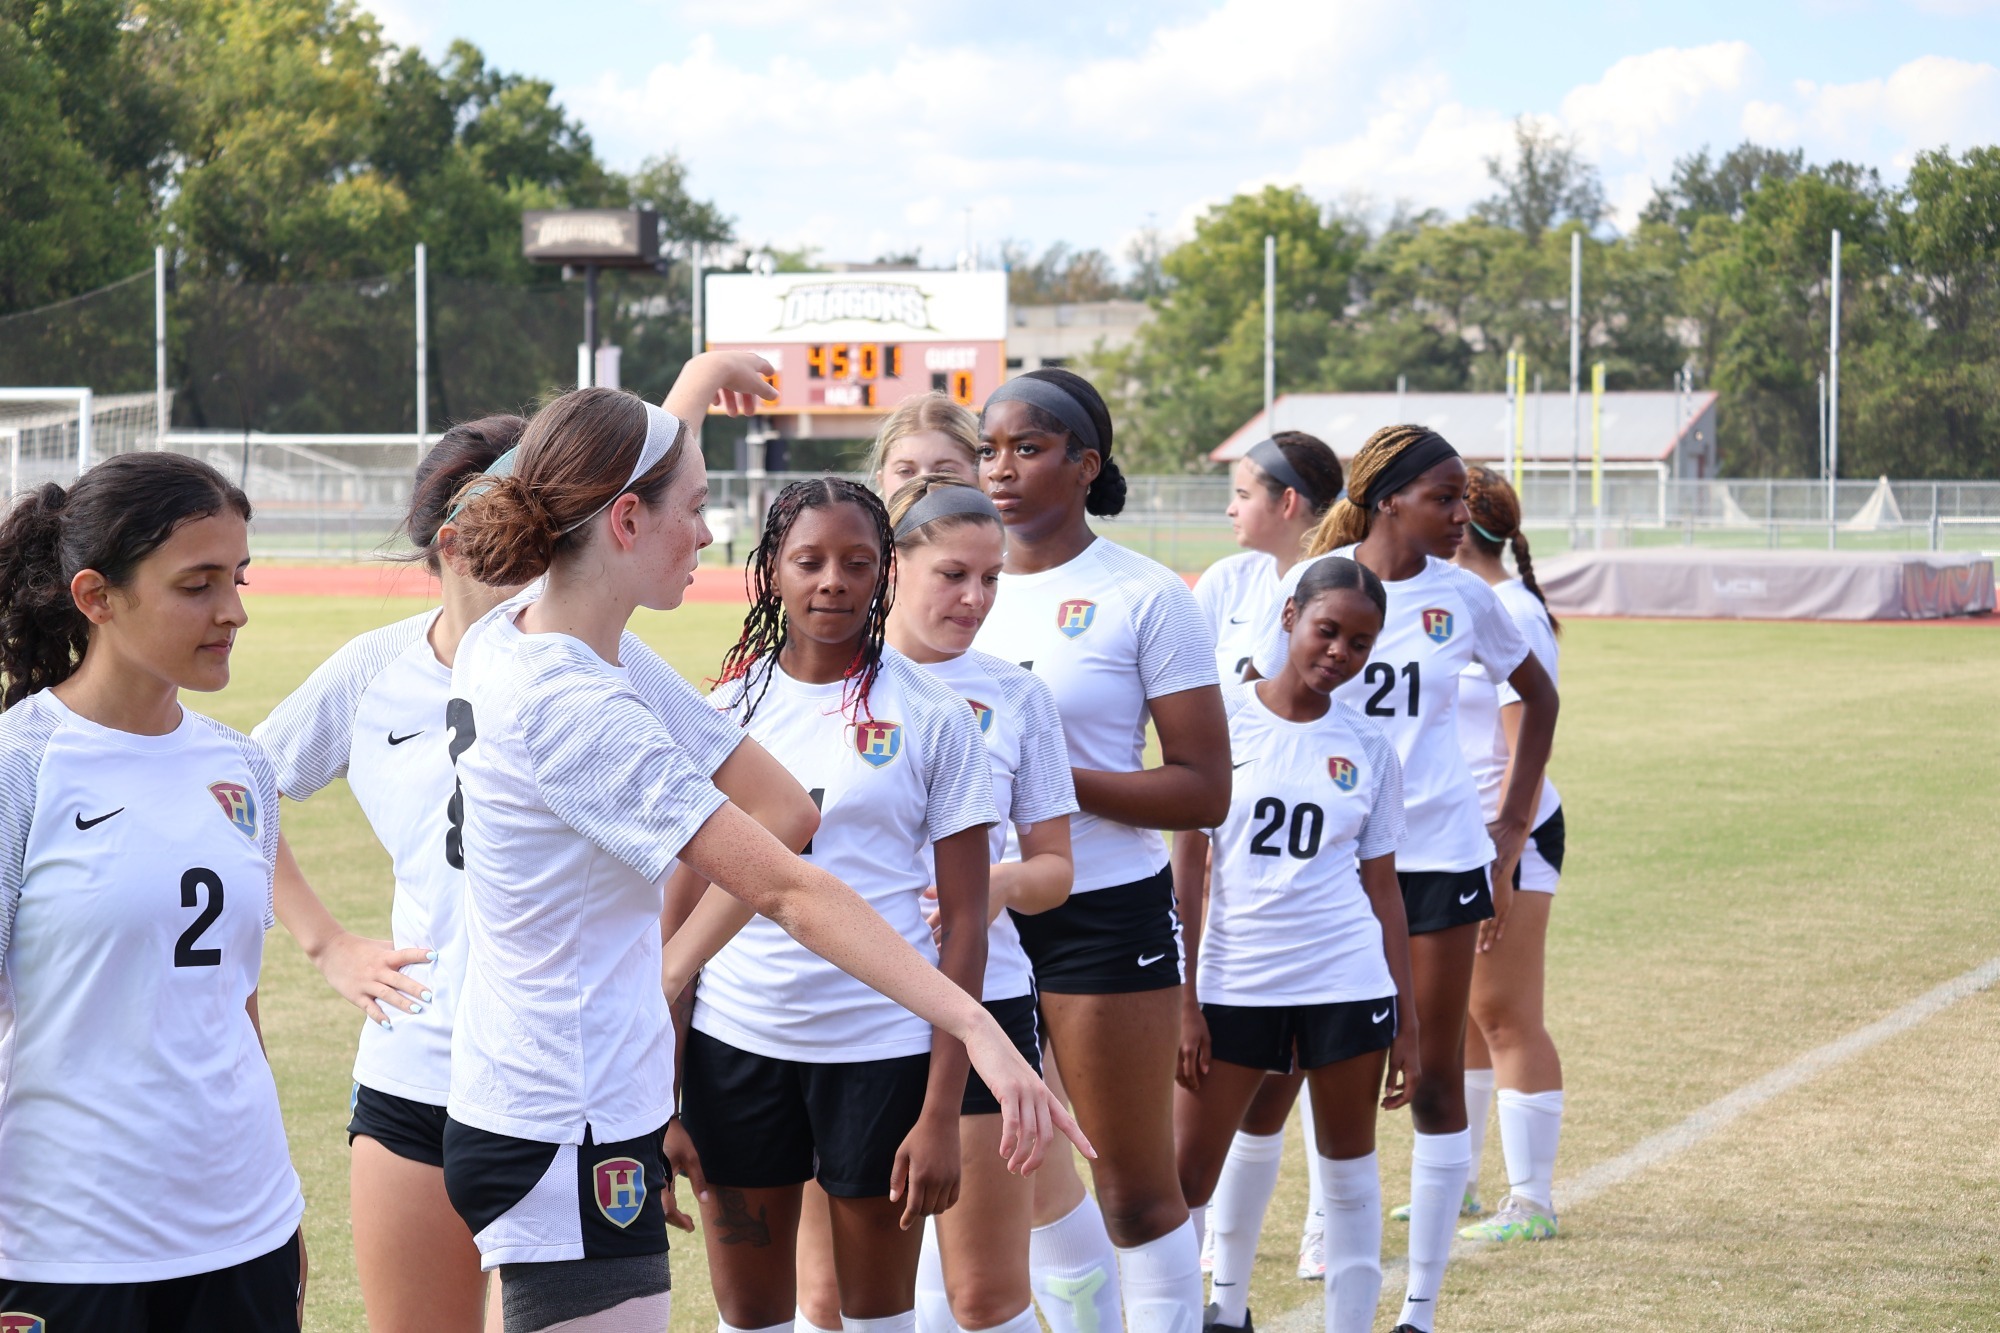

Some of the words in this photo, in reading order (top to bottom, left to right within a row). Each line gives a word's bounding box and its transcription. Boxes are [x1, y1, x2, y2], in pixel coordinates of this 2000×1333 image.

[782, 289, 928, 328] DRAGONS
[953, 370, 973, 406] 0
[1364, 661, 1420, 717] 21
[1250, 797, 1324, 860] 20
[174, 867, 224, 967] 2
